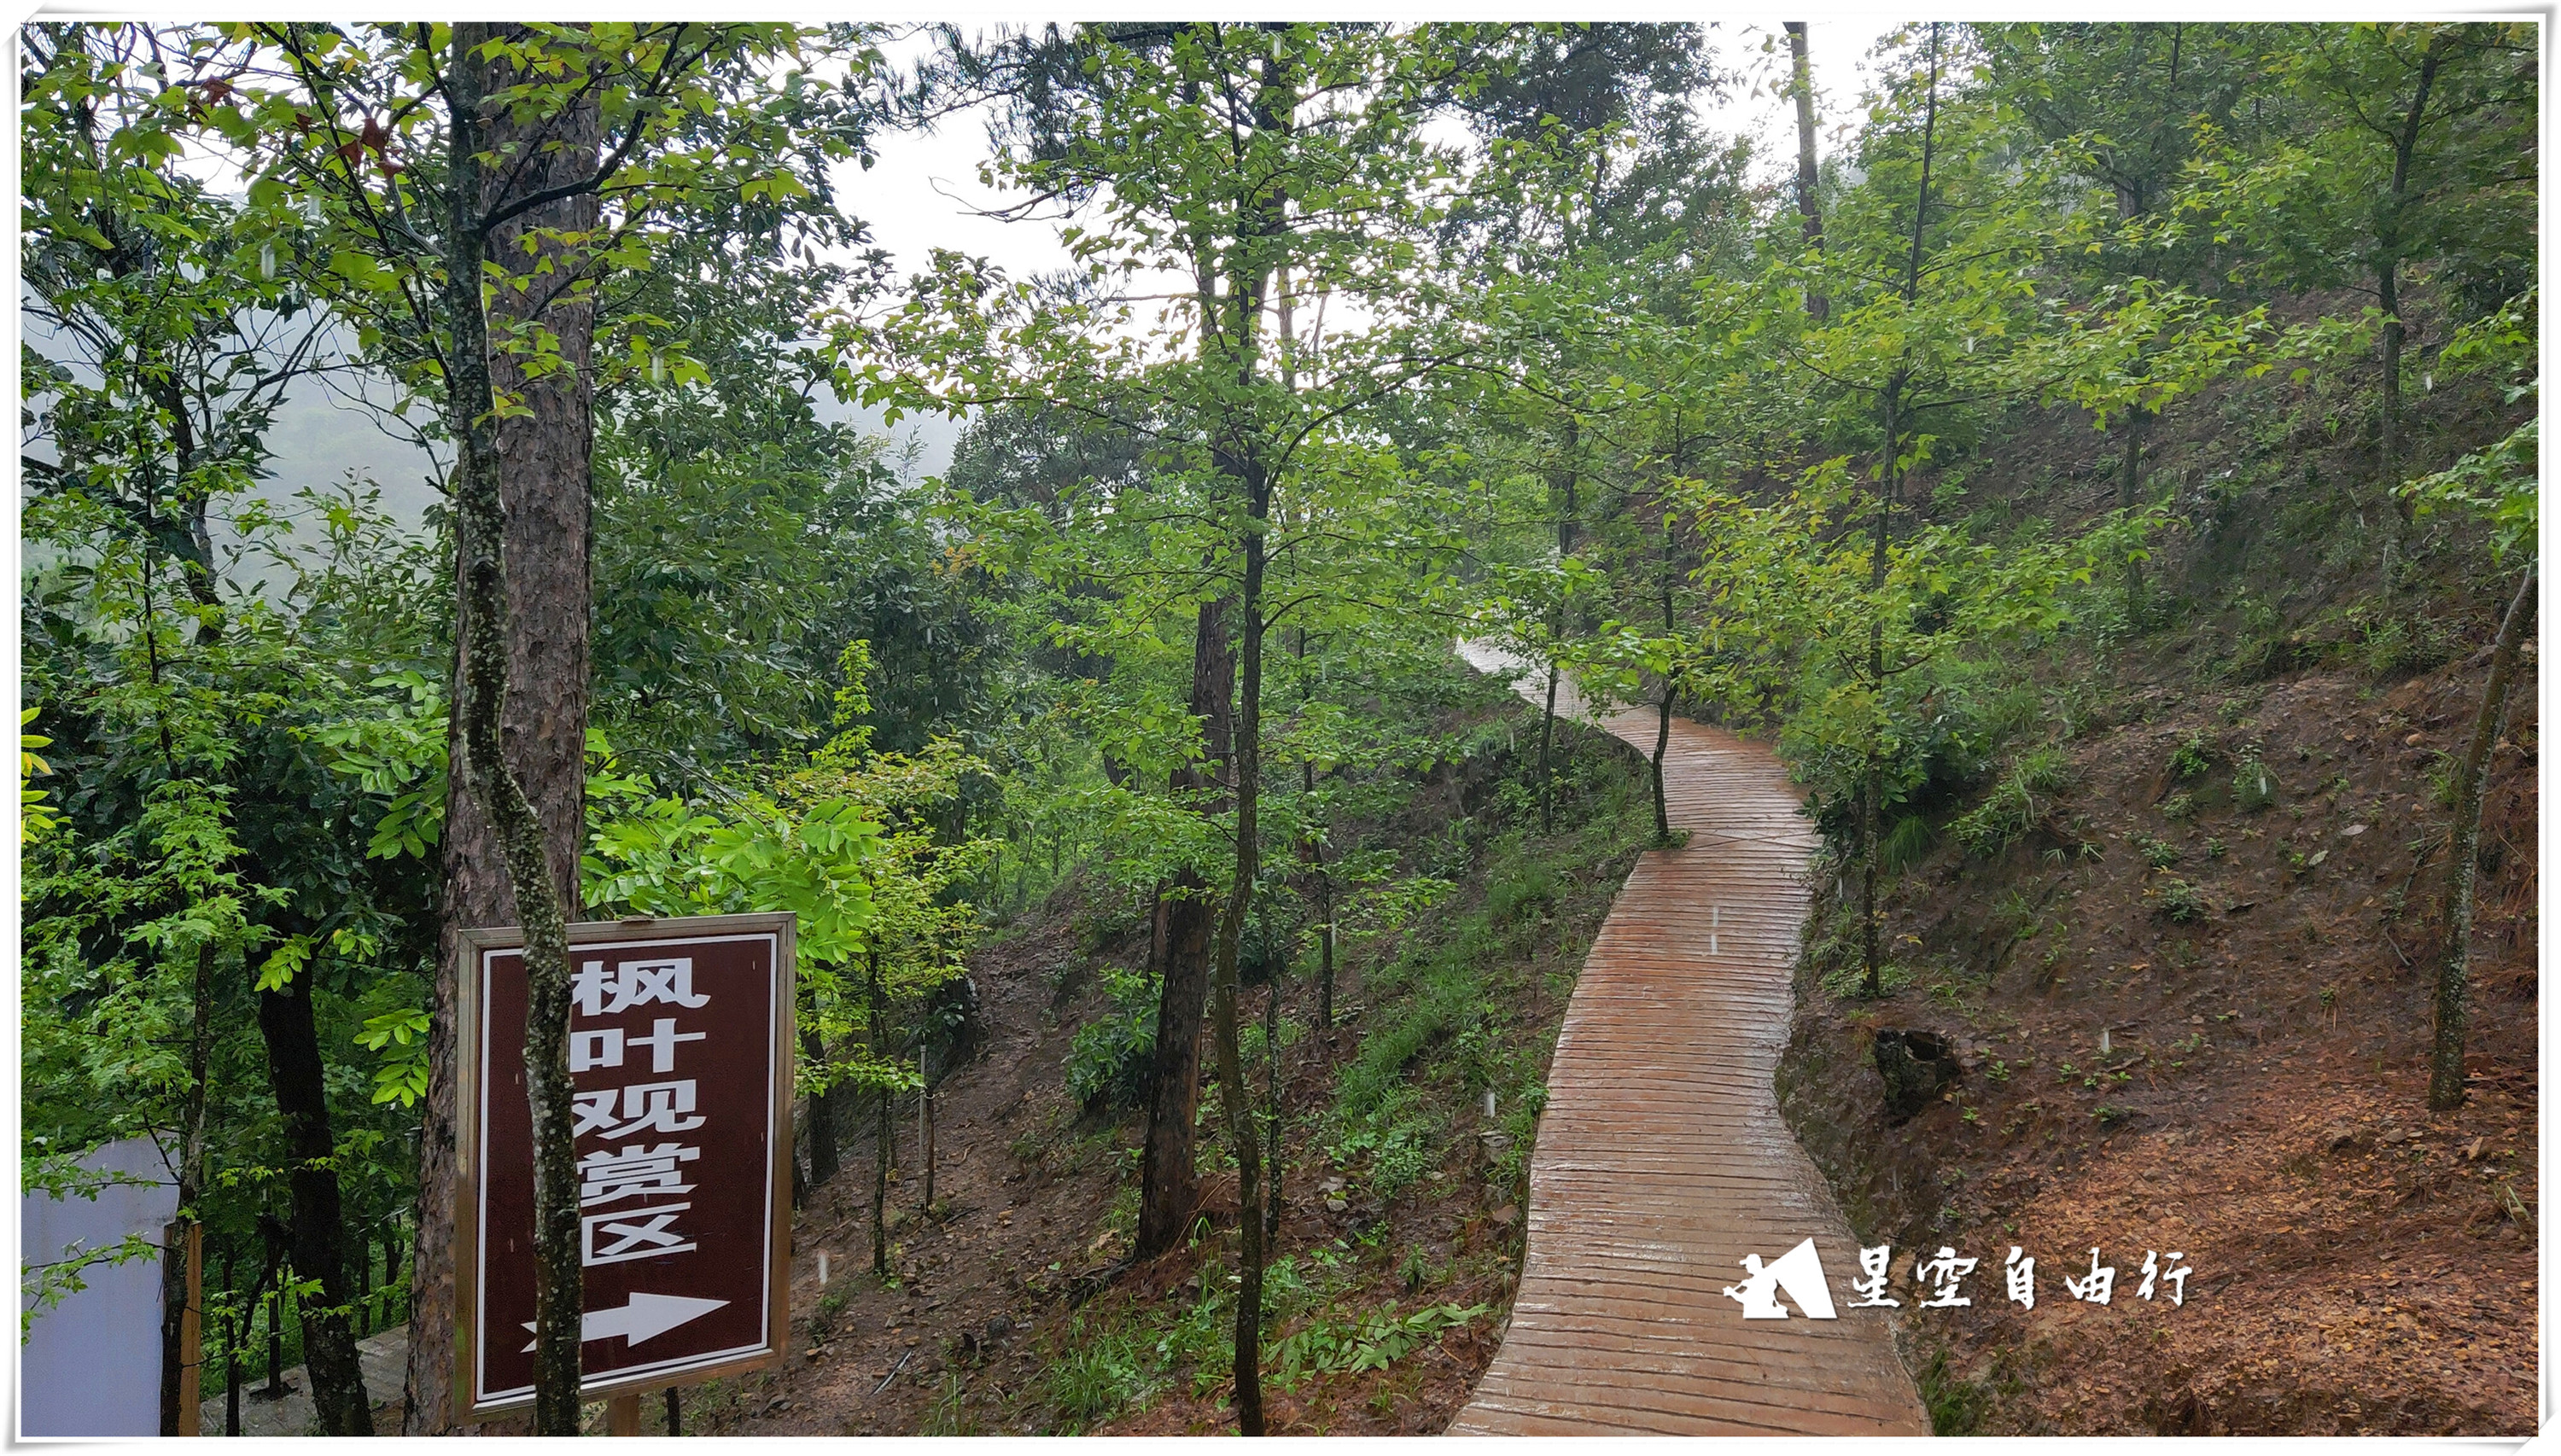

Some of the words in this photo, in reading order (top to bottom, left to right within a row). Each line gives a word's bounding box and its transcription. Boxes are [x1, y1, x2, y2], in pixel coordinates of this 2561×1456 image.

[569, 957, 710, 1267] 枫叶观赏区
